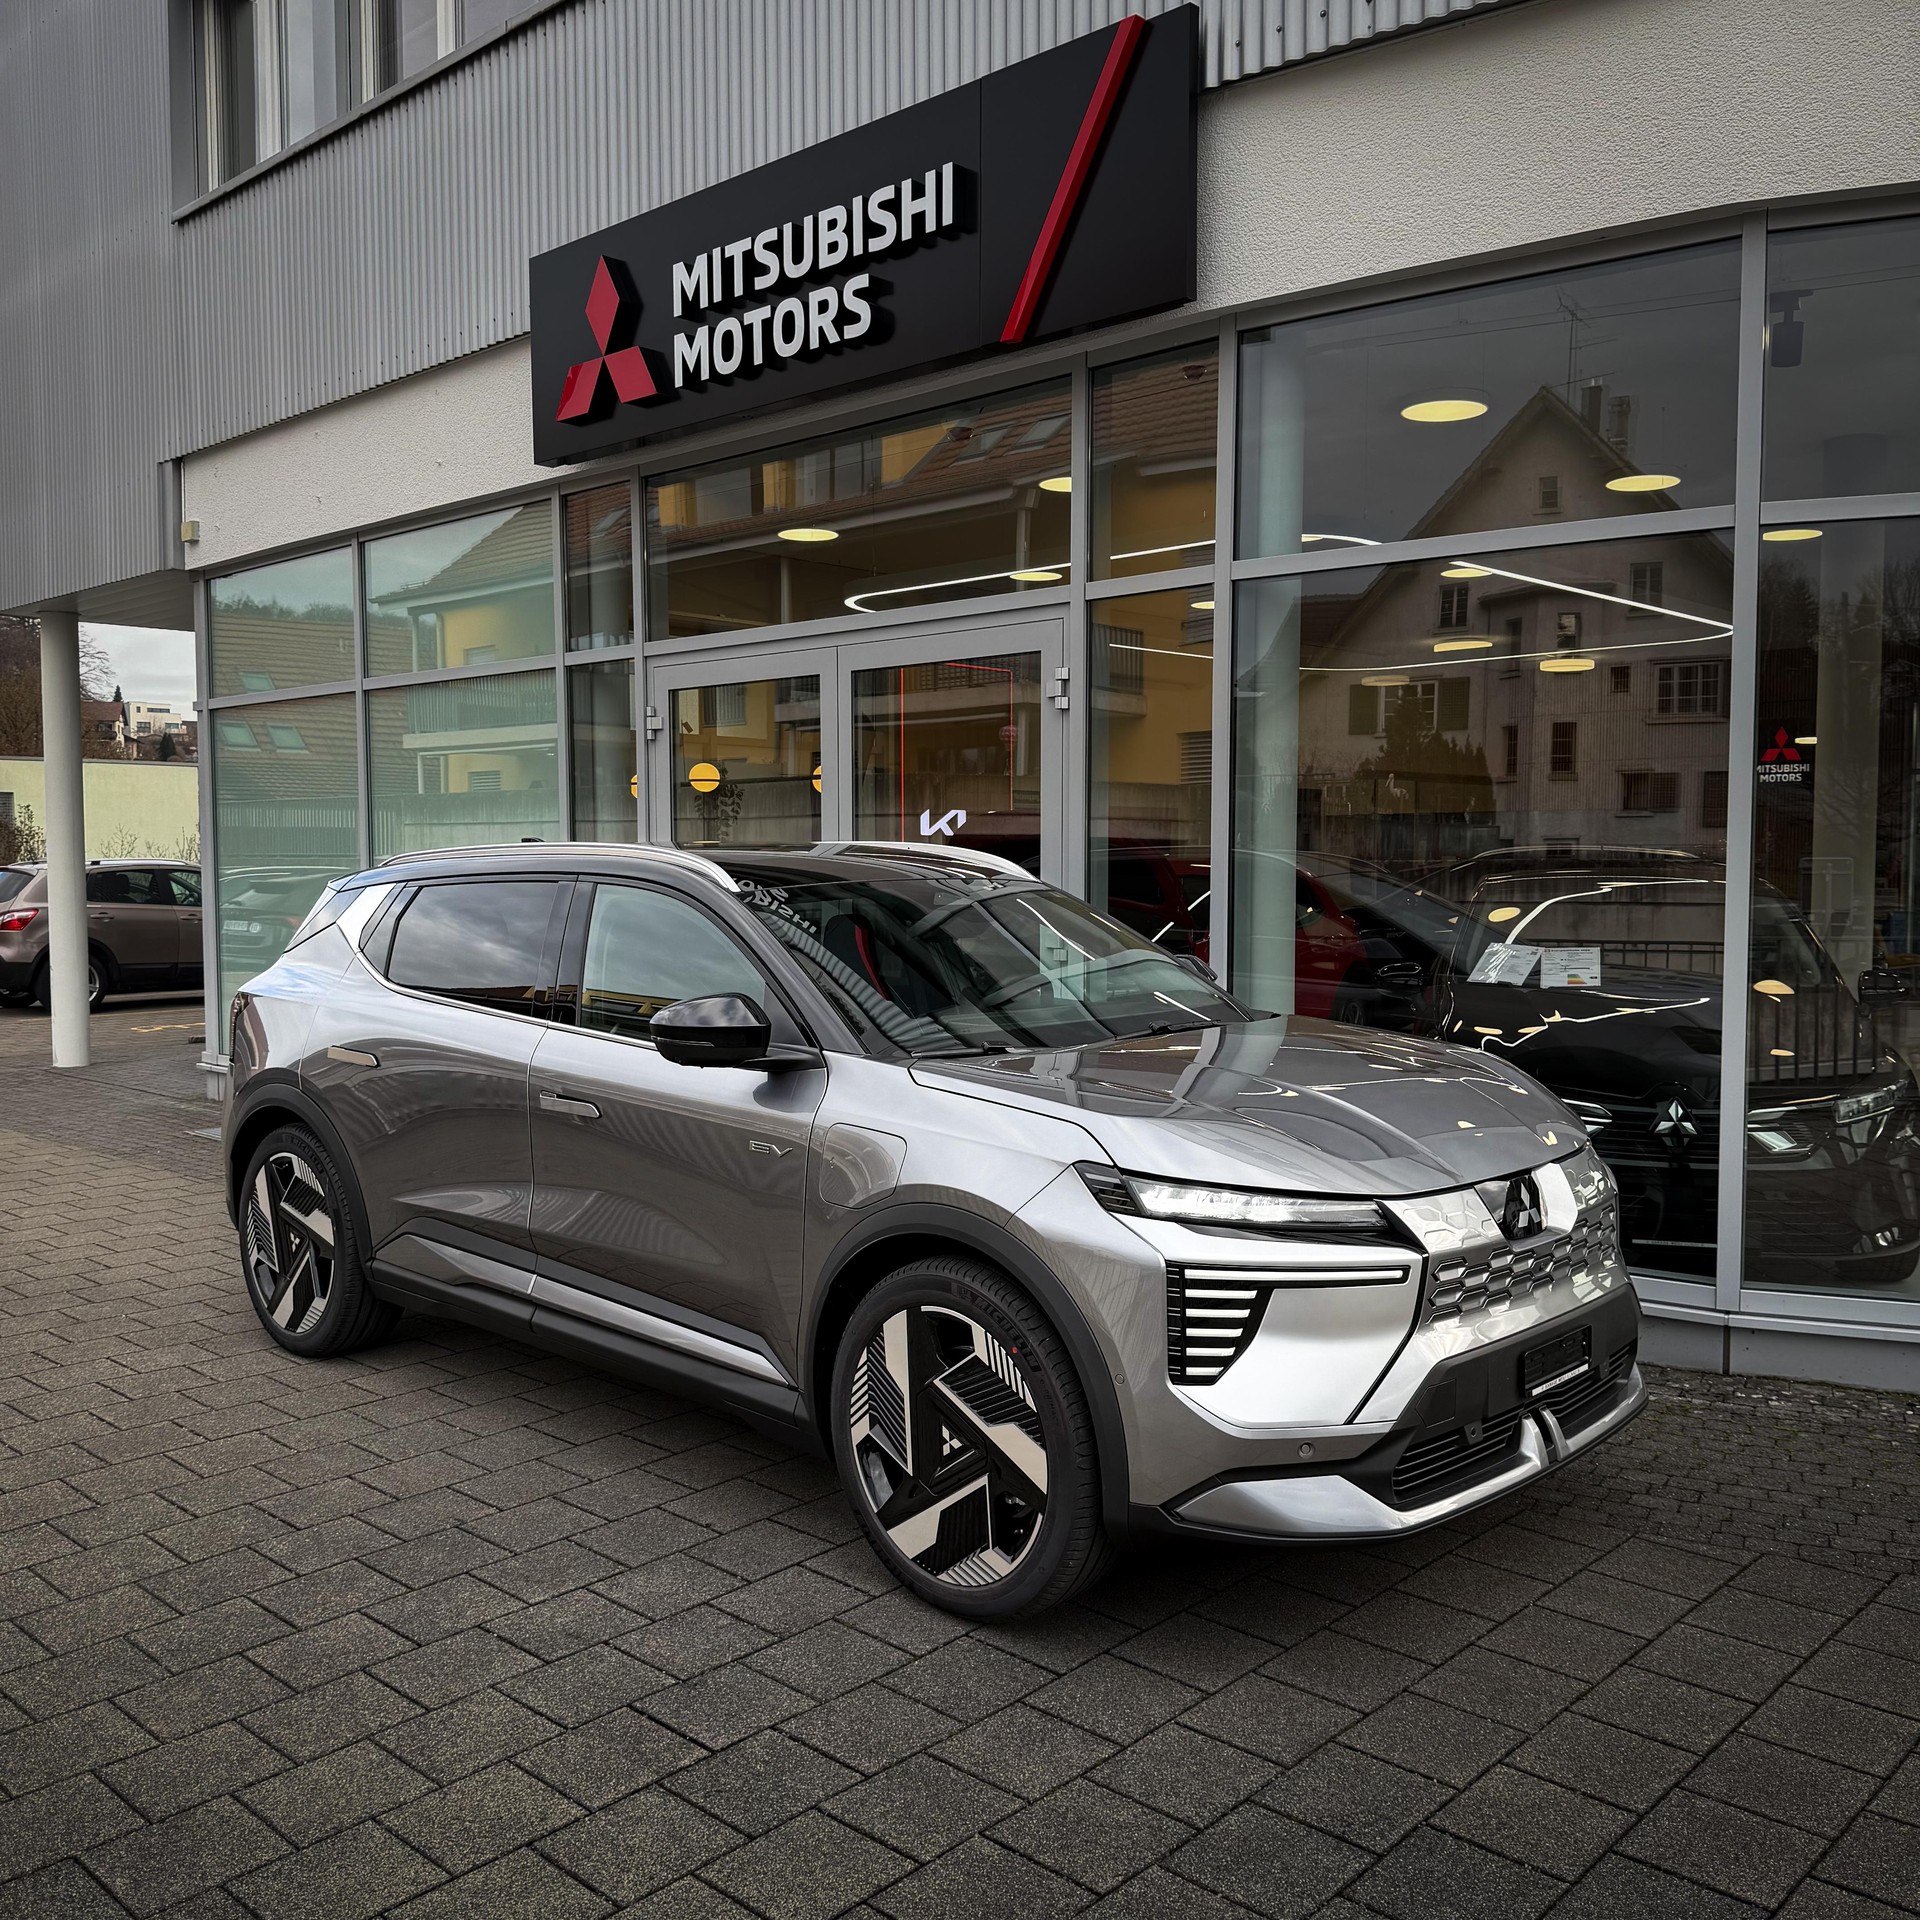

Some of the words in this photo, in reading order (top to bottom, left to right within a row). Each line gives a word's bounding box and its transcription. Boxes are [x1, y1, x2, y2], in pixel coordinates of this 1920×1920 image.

[672, 161, 953, 317] MITSUBISHI
[673, 273, 871, 388] MOTORS
[1760, 774, 1802, 782] MOTORS
[748, 1140, 793, 1158] EV
[972, 1295, 1040, 1369] MICHELIN
